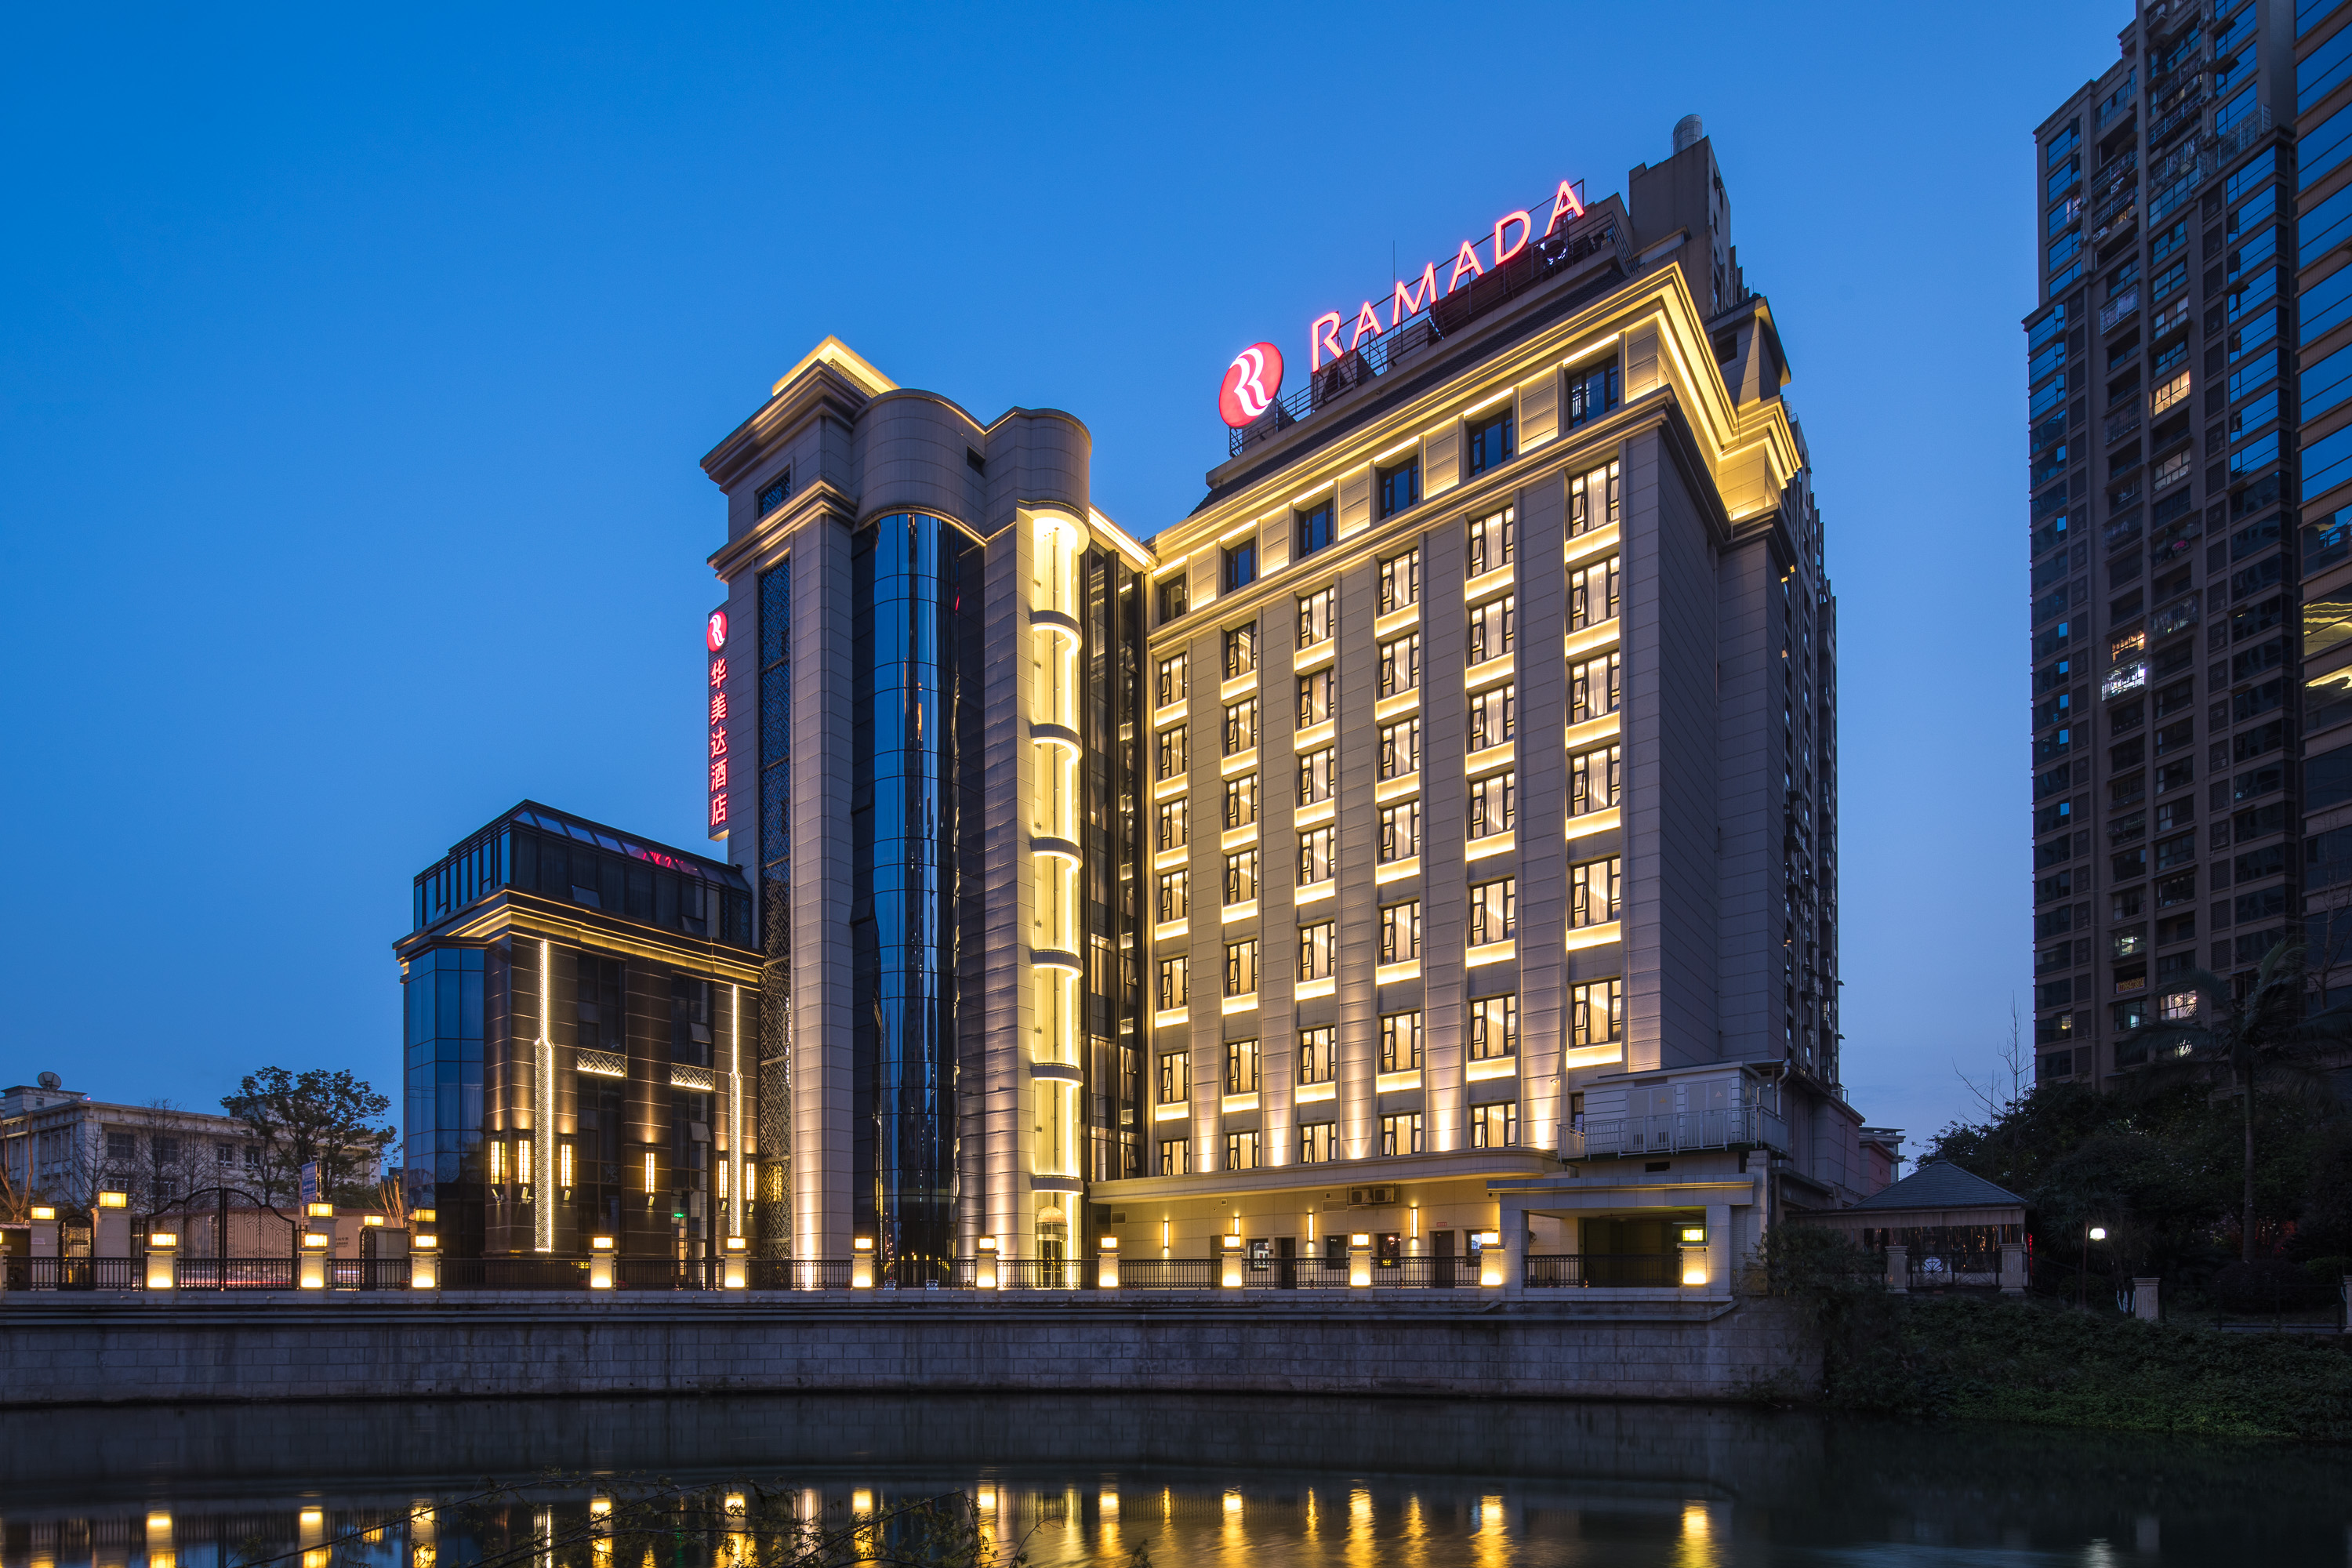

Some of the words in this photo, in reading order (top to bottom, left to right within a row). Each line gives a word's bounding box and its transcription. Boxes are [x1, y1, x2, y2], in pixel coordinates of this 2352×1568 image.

[1311, 180, 1585, 373] RAMADA
[710, 658, 727, 826] 华美达酒店
